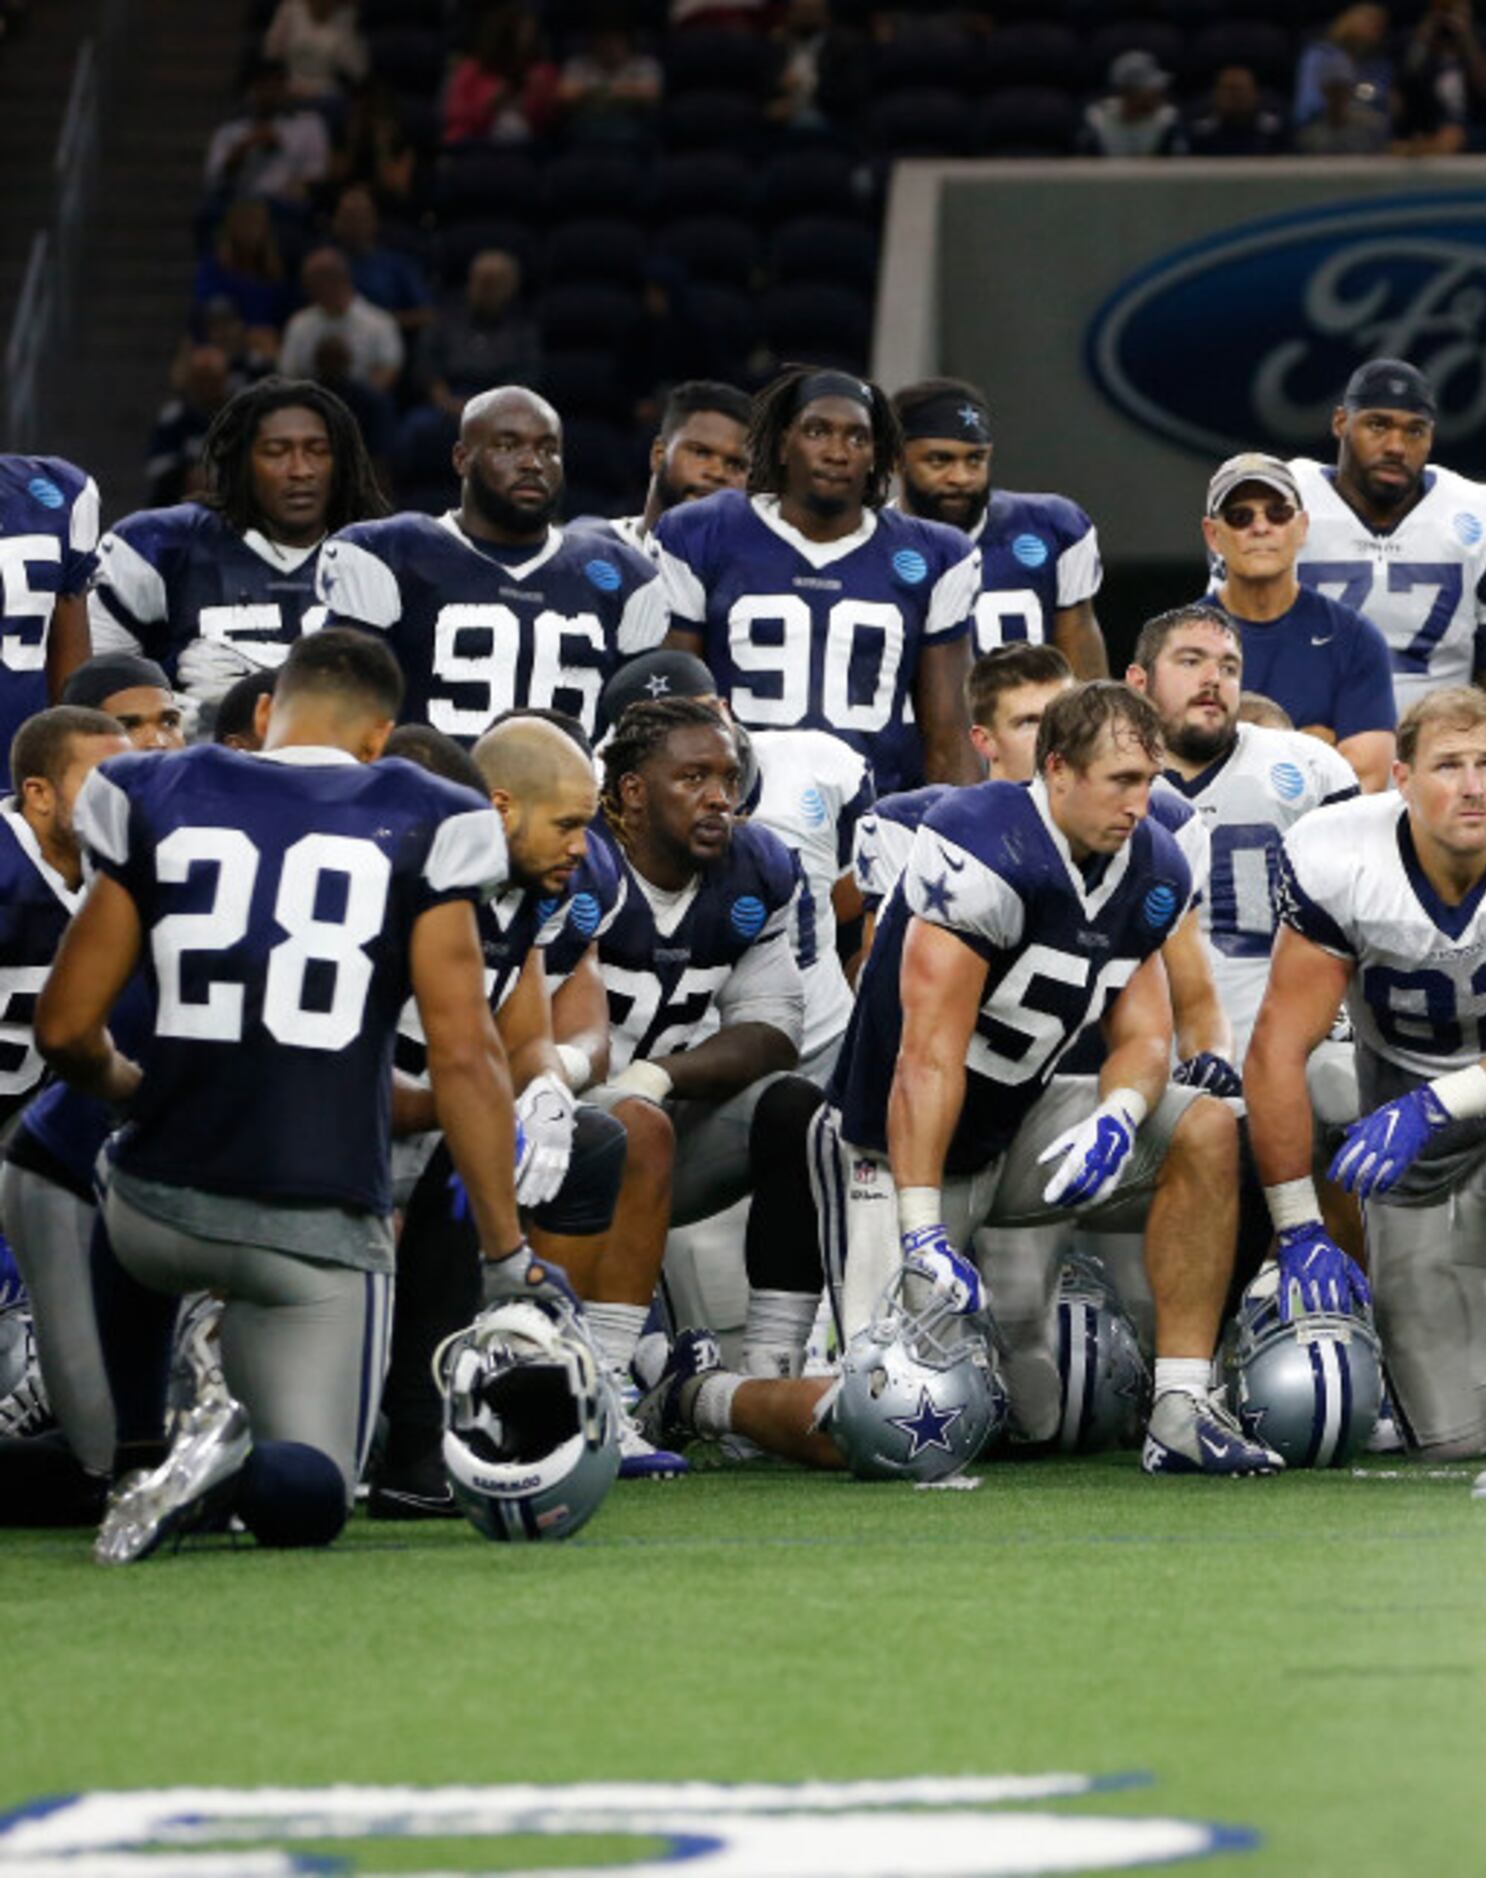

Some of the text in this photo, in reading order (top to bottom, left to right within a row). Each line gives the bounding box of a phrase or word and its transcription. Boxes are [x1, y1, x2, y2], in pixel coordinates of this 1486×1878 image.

[199, 602, 329, 668] 5
[427, 604, 606, 740] 96
[728, 594, 904, 732] 90
[1297, 560, 1463, 673] 77
[151, 826, 392, 1052] 28
